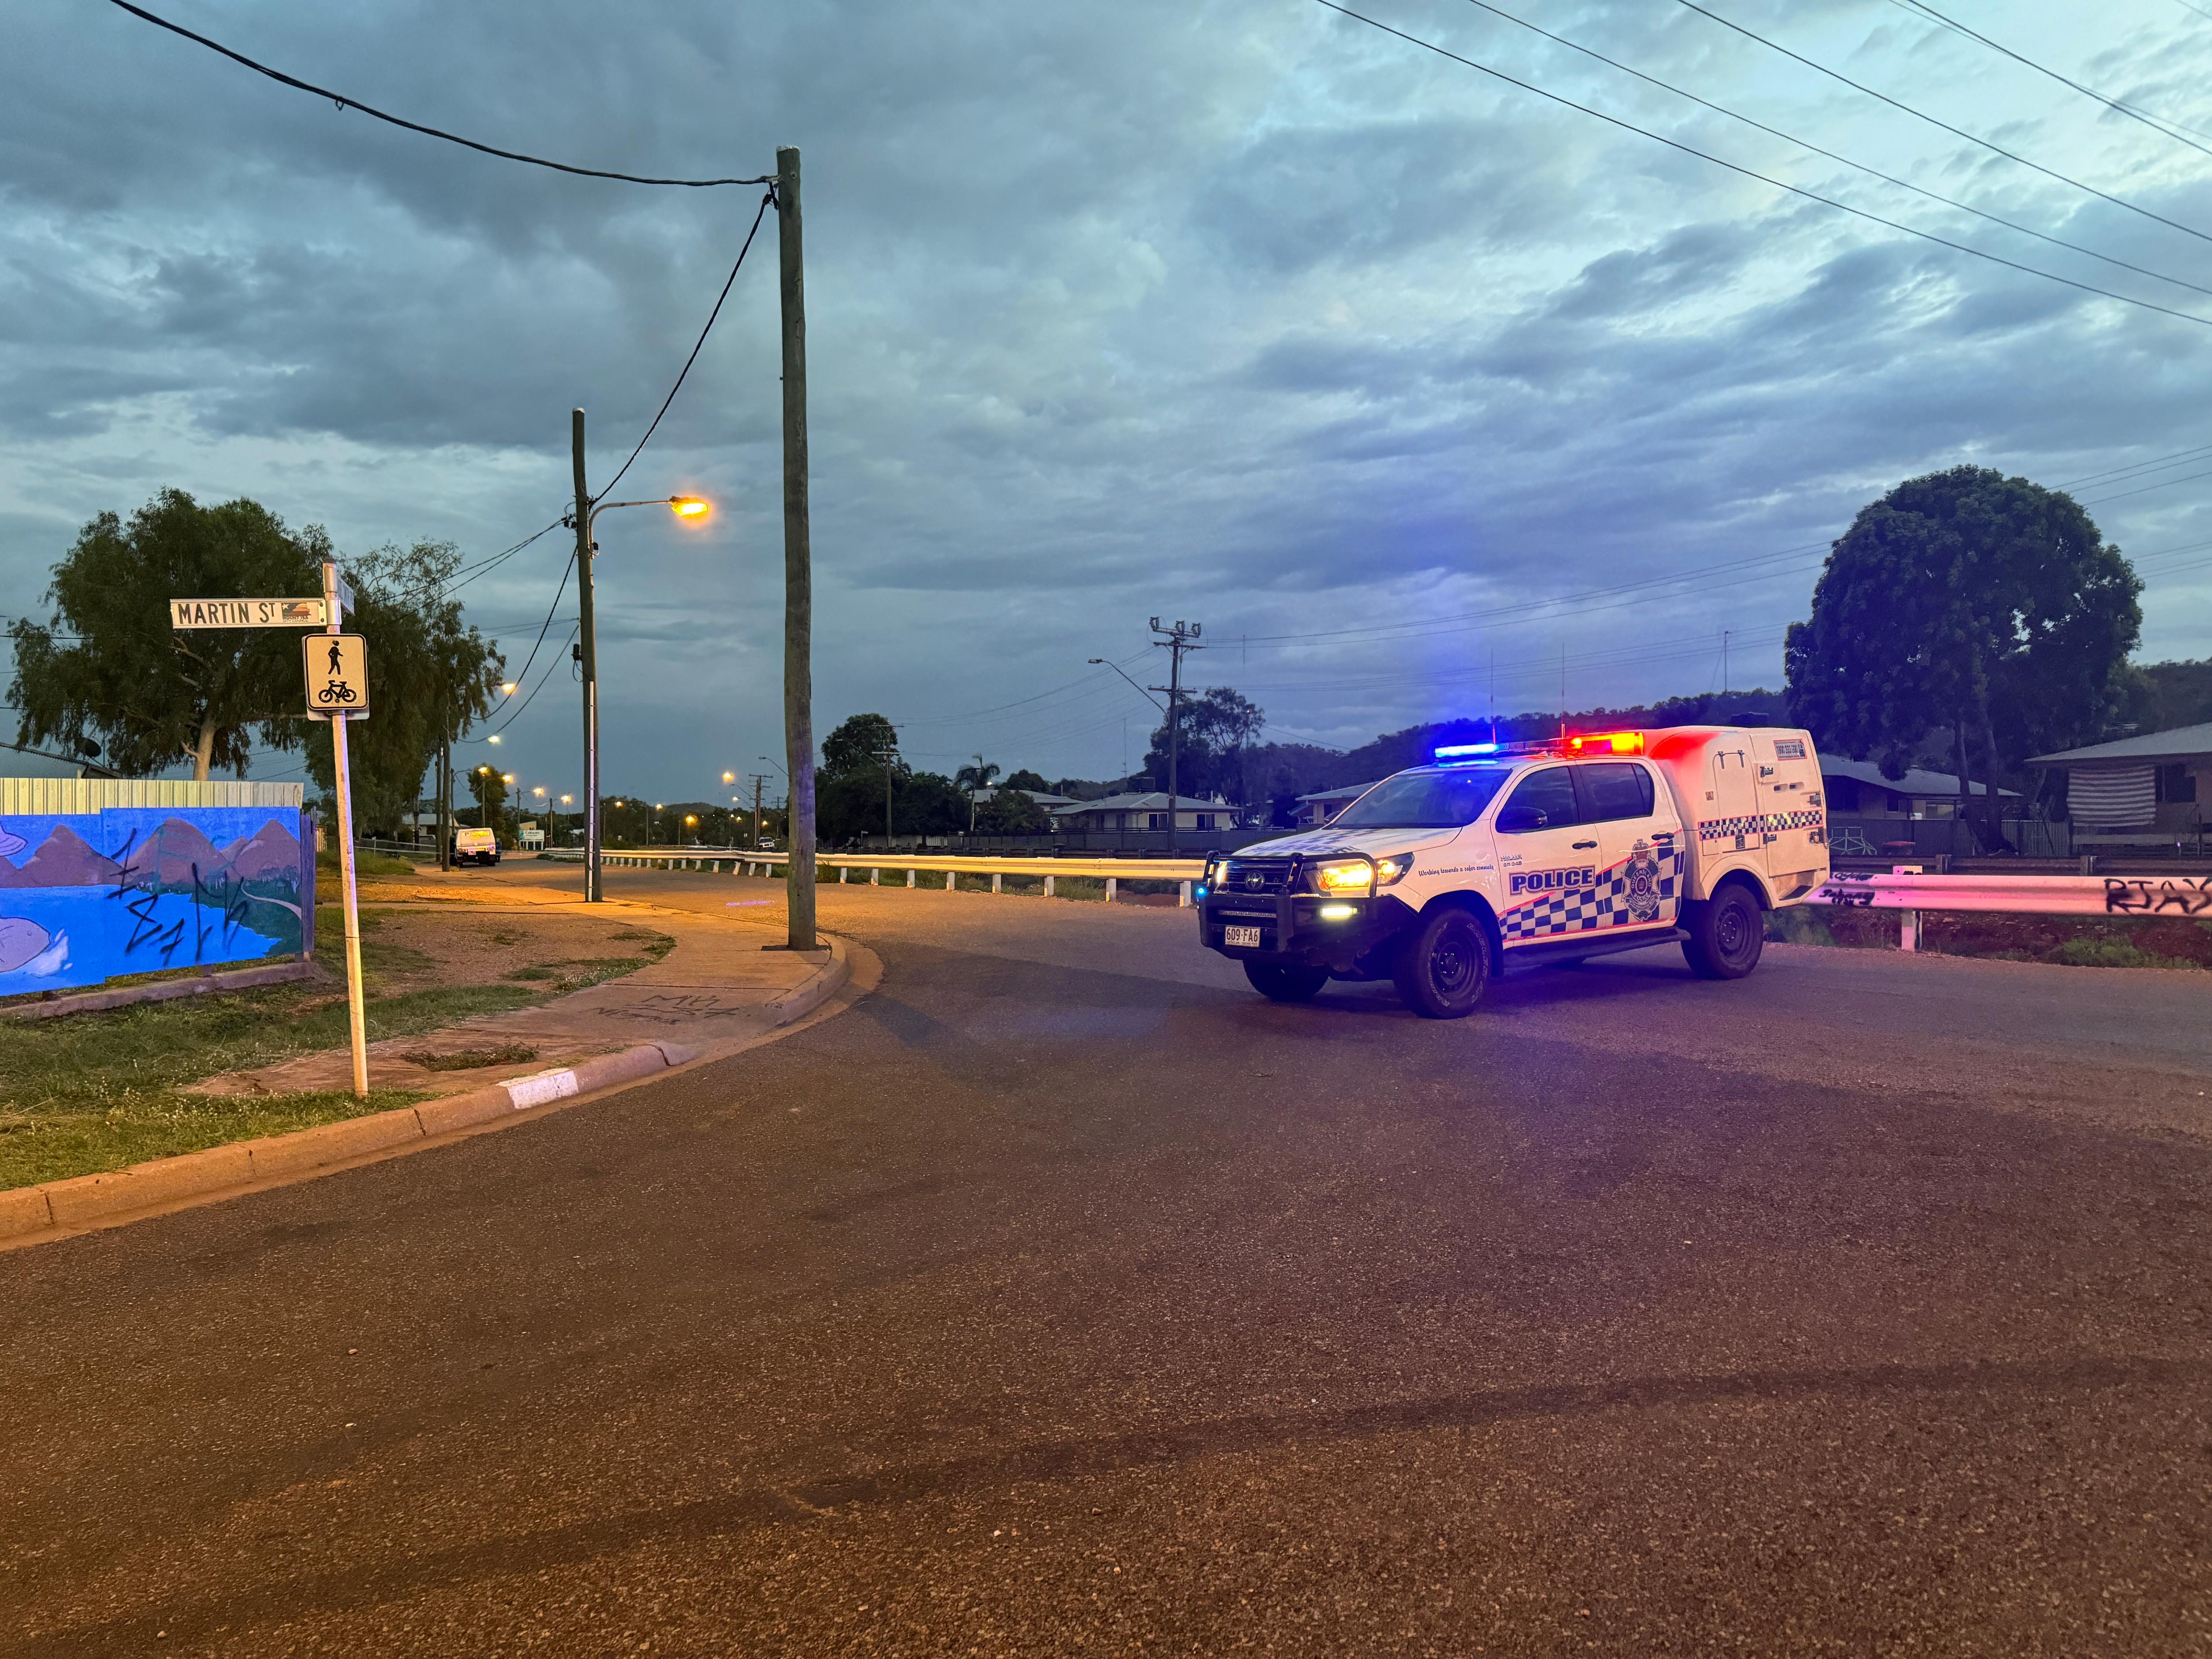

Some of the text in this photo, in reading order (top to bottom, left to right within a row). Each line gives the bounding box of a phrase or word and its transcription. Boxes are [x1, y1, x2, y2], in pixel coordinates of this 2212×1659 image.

[178, 602, 275, 624] MARTIN ST
[1510, 867, 1594, 893] POLICE
[1631, 868, 1652, 889] QUEENSLAND
[1633, 891, 1650, 900] POLICE
